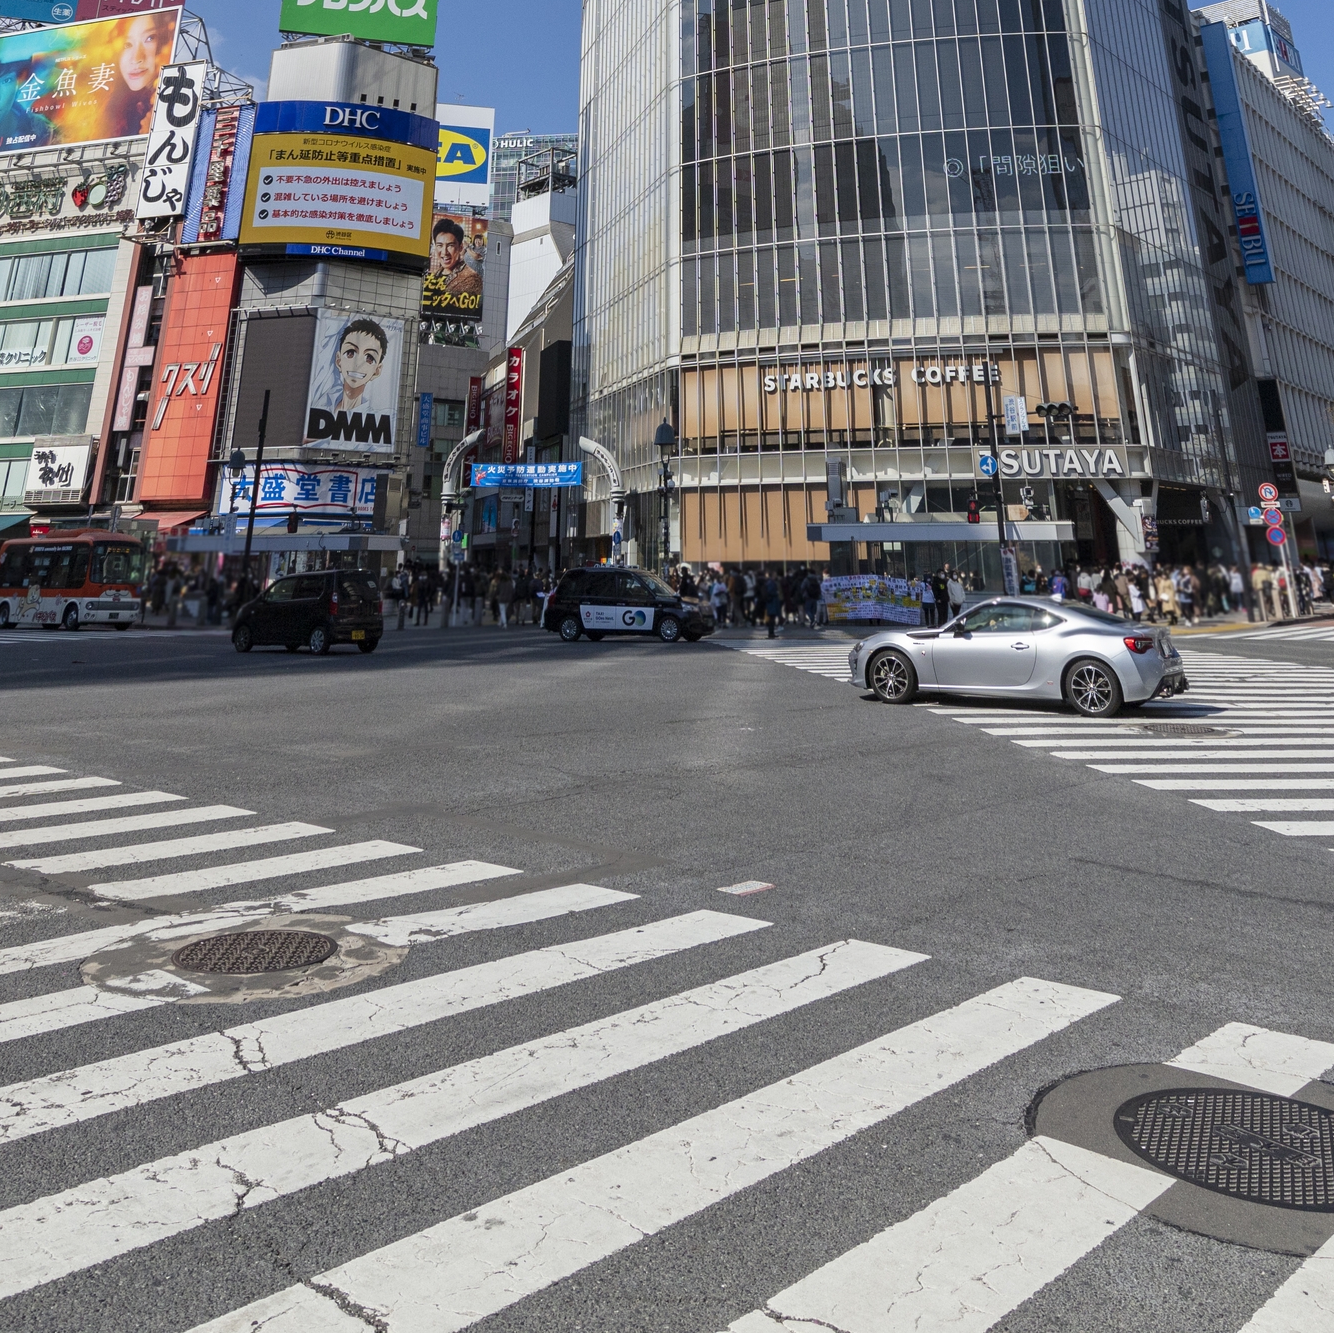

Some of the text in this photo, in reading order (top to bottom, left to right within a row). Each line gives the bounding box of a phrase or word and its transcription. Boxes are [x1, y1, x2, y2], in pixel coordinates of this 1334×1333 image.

[17, 62, 116, 103] 金魚妻
[25, 98, 98, 114] Fishbowl Wives
[323, 106, 381, 130] DHC
[5, 133, 37, 146] 独占配信中
[142, 66, 199, 212] もんじゃ
[302, 137, 392, 153] 新型コロナウイルス感染症
[500, 138, 534, 148] HULIC
[268, 149, 427, 176] 「まん延防止等重点措置」 実施中
[979, 153, 1085, 176] 「間隙狙い
[275, 174, 403, 193] 不要不急の外出は控えましょう
[273, 192, 409, 212] 混雑している場所を避けましょう
[271, 209, 416, 231] 基本的な感染対策を徹底しましょう
[310, 245, 366, 257] DHC Channel
[505, 355, 521, 418] カラオケ
[763, 364, 1000, 393] STARBUCKS COFFEE
[306, 407, 392, 445] DMM
[1272, 443, 1289, 459] 本
[487, 464, 578, 474] 火災予防運動実施中
